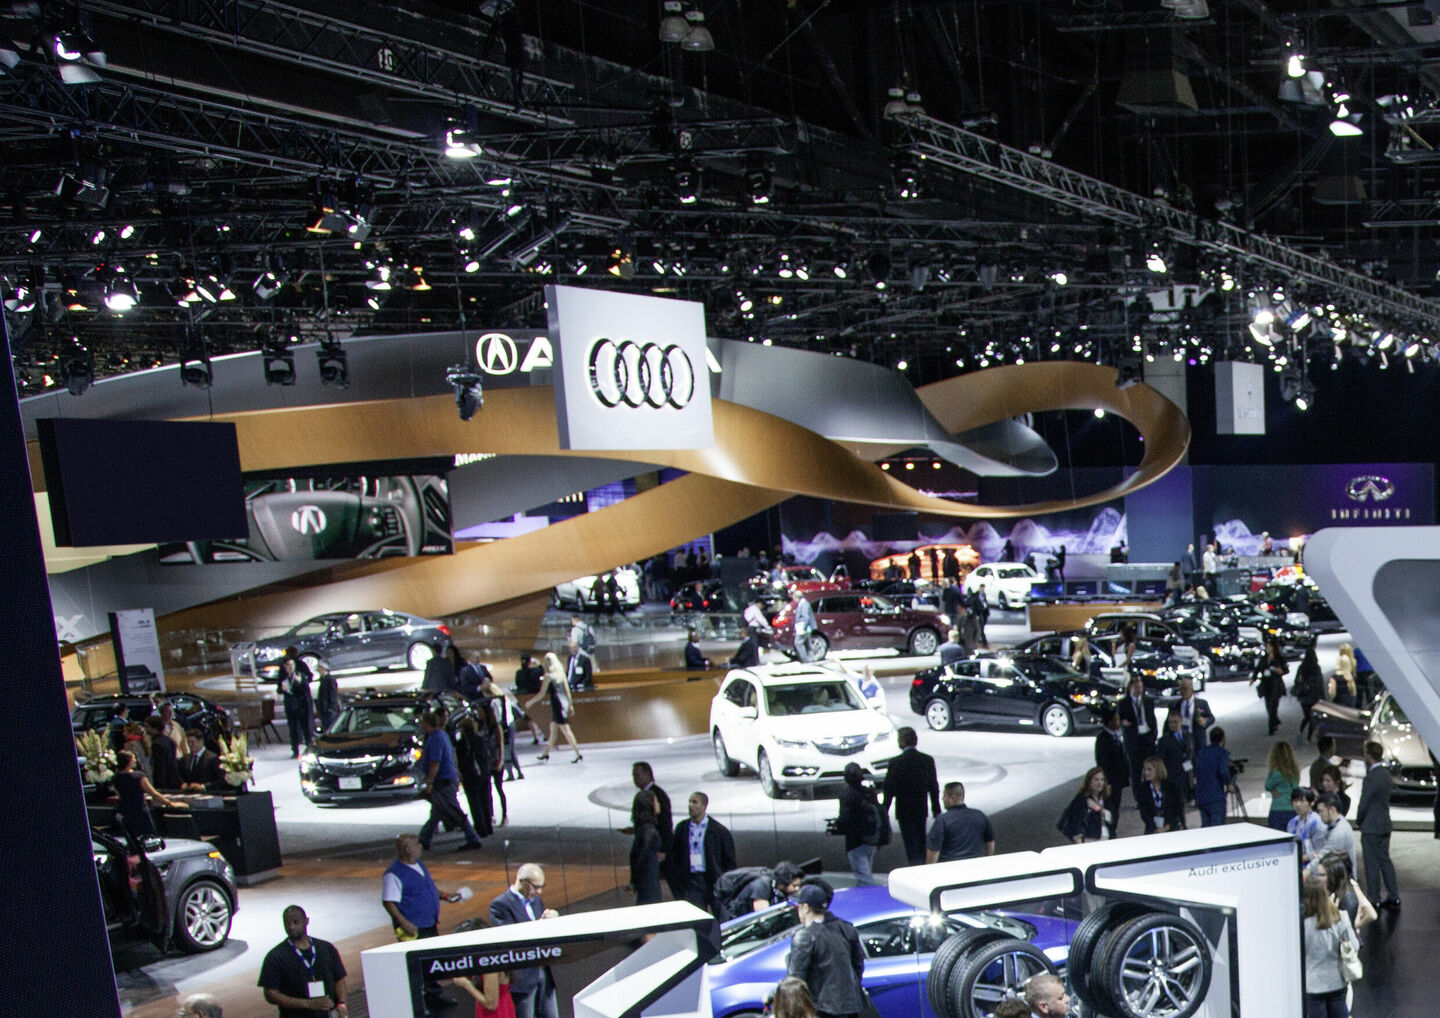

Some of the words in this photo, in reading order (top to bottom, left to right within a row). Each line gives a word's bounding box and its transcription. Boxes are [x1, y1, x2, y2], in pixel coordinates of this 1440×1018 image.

[1331, 508, 1410, 519] INFINITI
[1188, 864, 1218, 878] Audi
[1222, 857, 1280, 873] exclusive
[429, 955, 474, 974] Audi
[478, 946, 562, 967] exclusive
